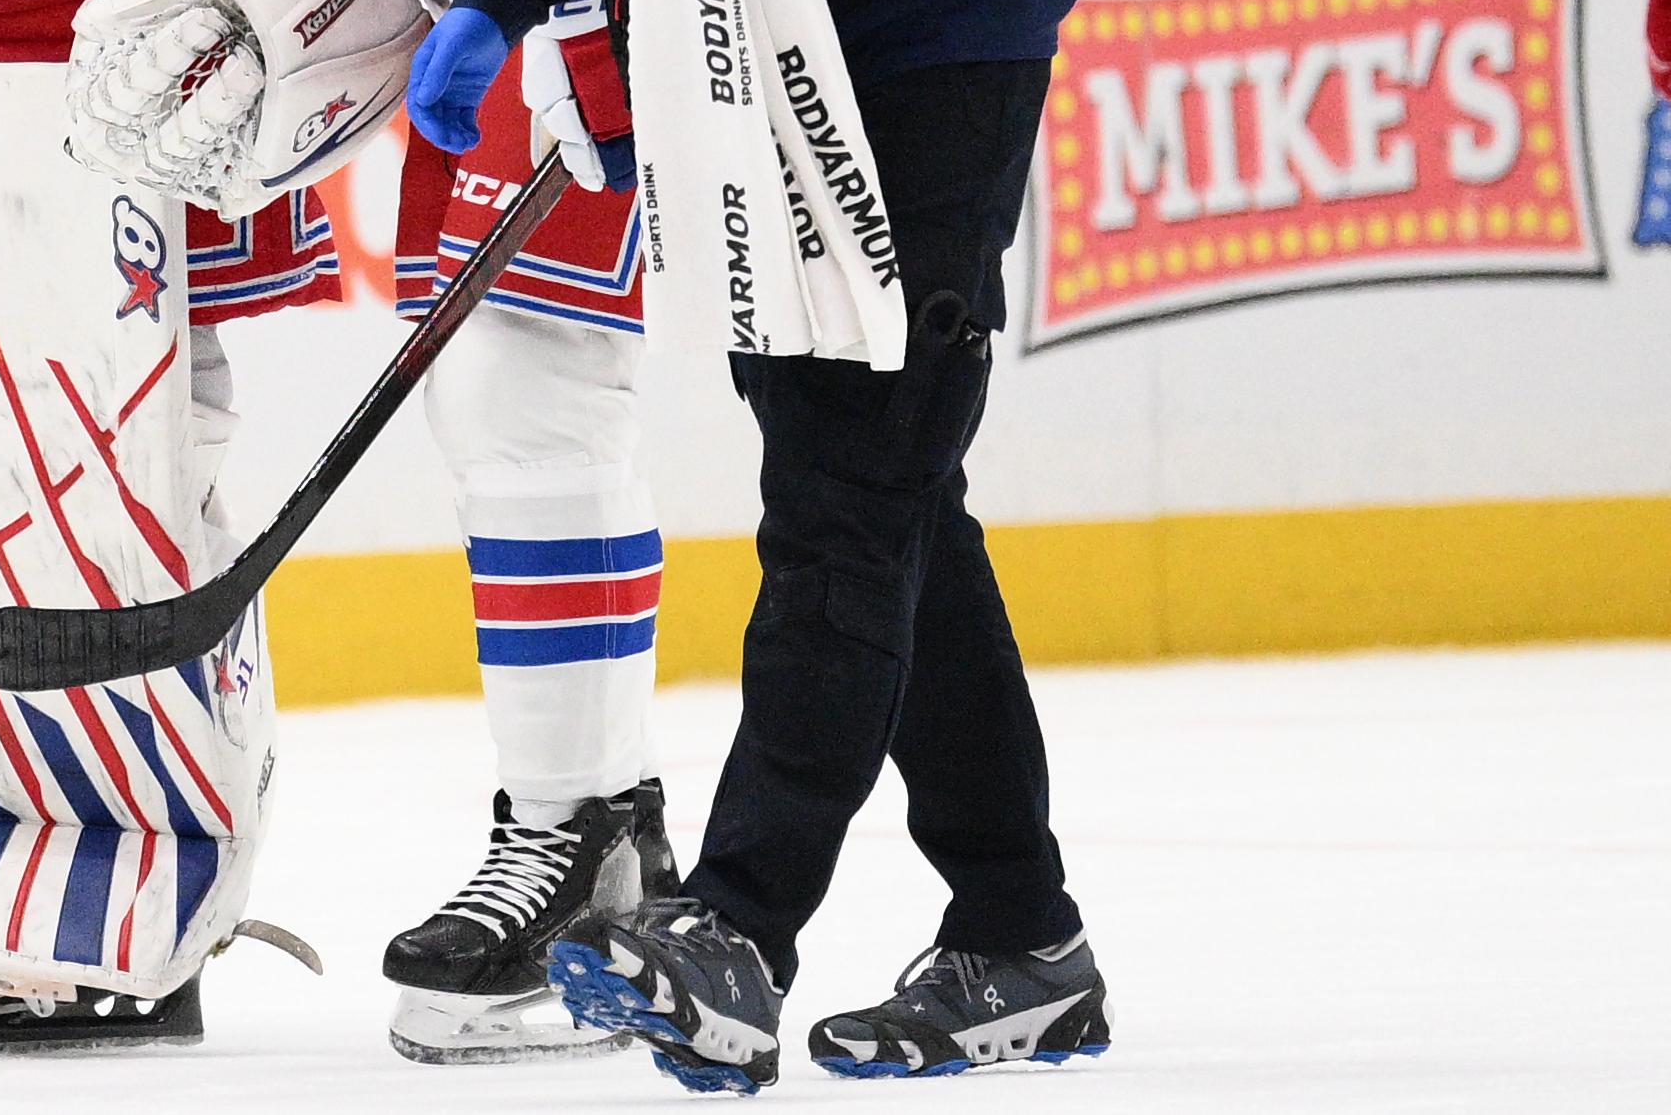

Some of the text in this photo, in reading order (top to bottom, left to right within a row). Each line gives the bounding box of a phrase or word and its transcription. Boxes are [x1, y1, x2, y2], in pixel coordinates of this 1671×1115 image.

[739, 46, 754, 107] SPORTS
[1085, 16, 1523, 233] MIKE'S
[642, 162, 665, 273] SPORTS DRINK
[777, 44, 903, 289] BODYARMOR
[236, 656, 254, 707] 31
